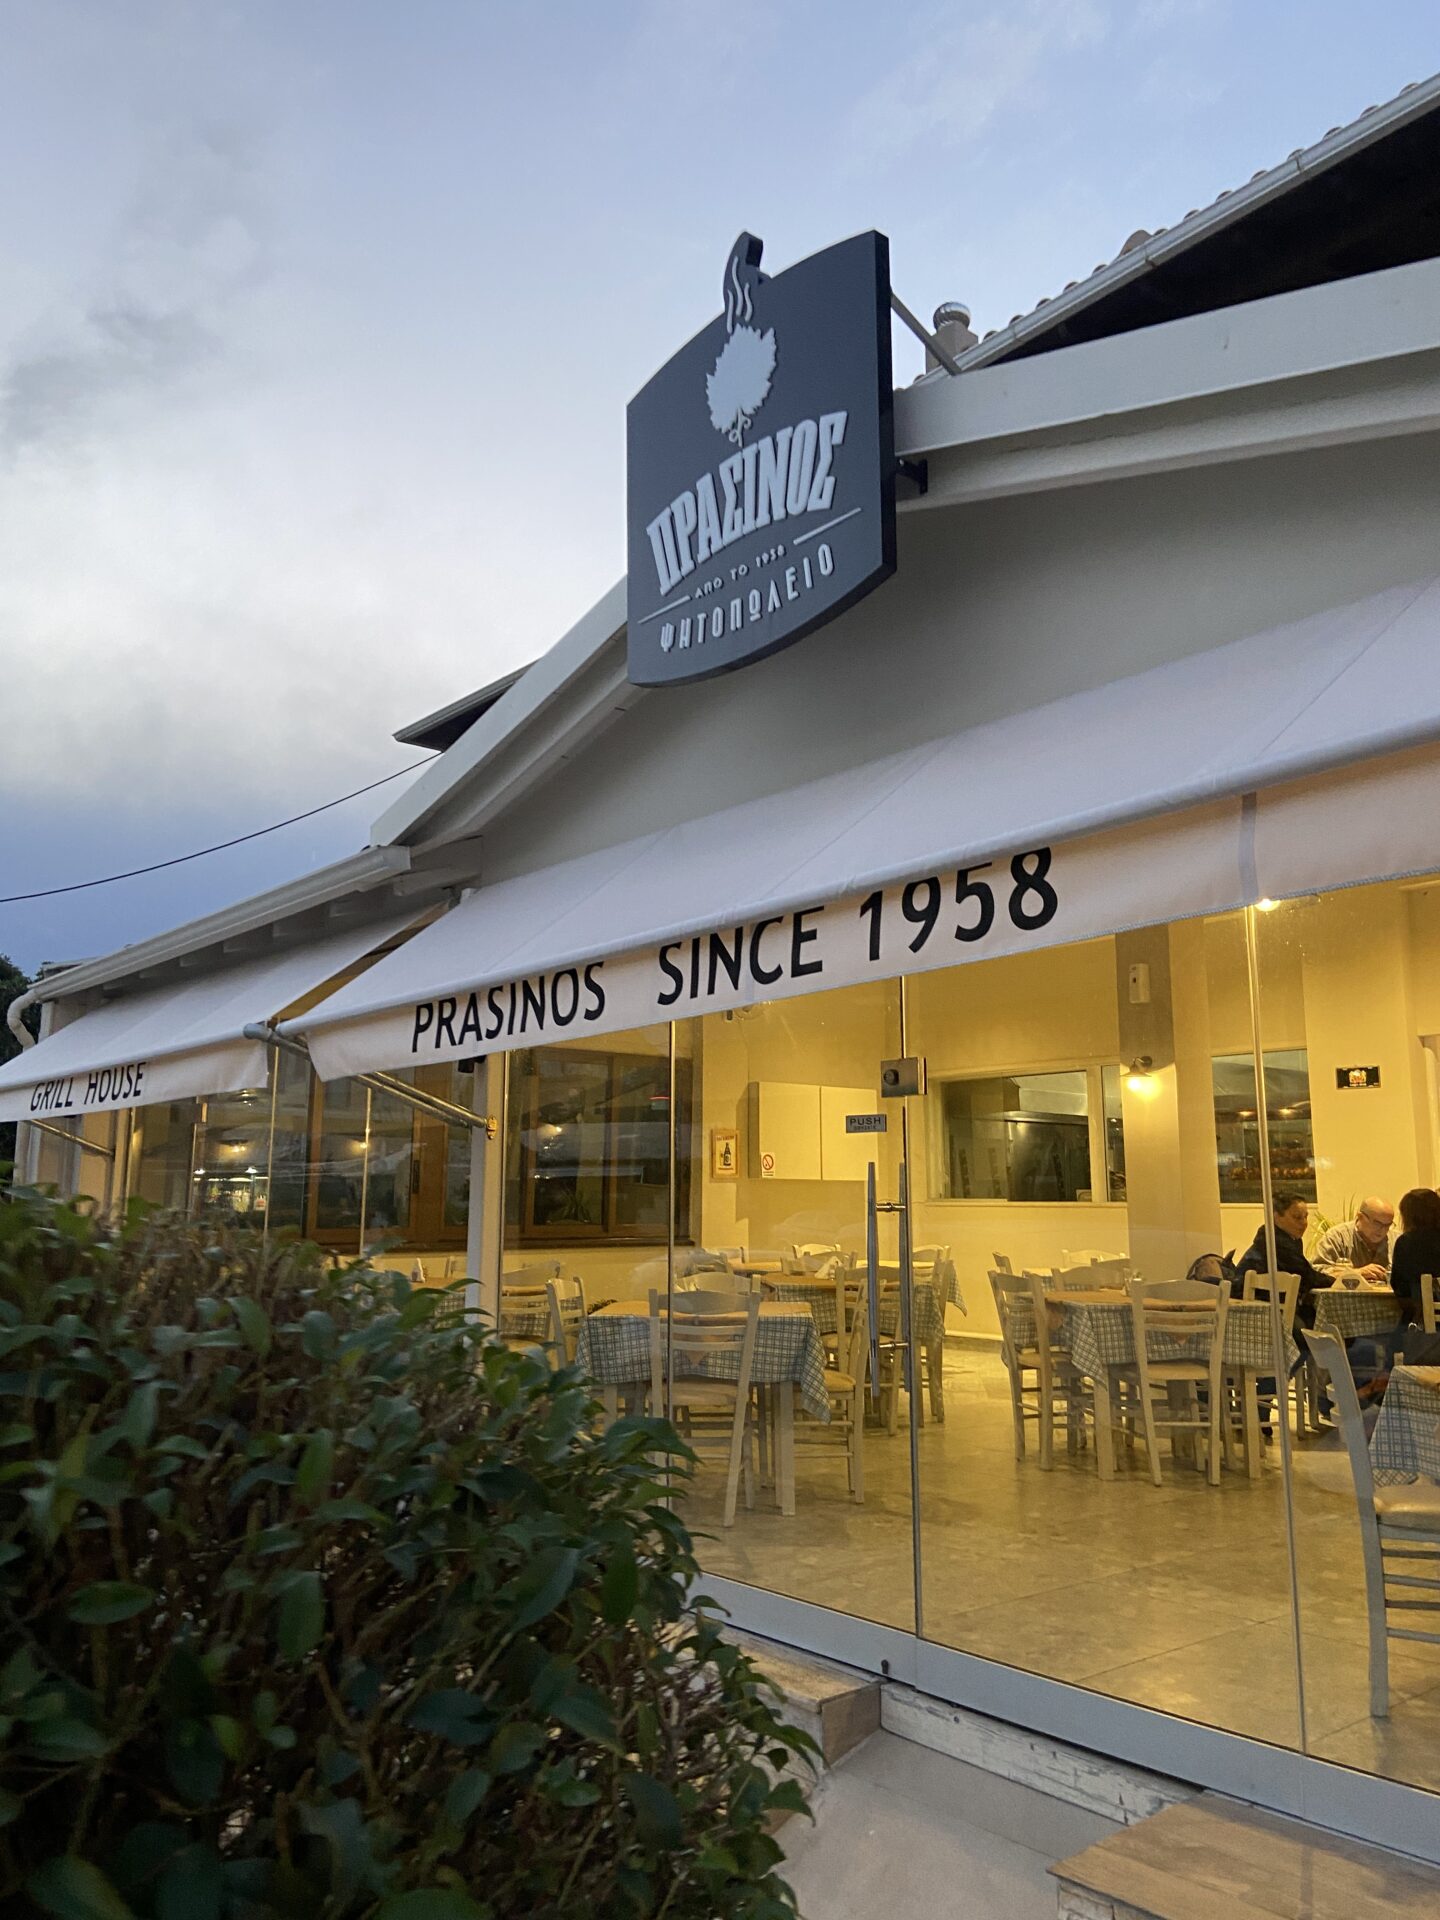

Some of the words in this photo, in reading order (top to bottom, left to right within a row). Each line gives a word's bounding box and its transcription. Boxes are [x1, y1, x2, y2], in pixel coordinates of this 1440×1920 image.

[646, 411, 848, 596] ΠΡΑΣΙΝΟΣ
[661, 543, 834, 653] ΨΗΤΟΠΩΛΕΙΟ
[695, 577, 723, 598] ΑΠΟ
[730, 564, 748, 580] ΤΟ
[756, 544, 785, 568] 1958
[411, 961, 605, 1053] PRASINOS
[657, 905, 825, 1006] SINCE
[860, 847, 1058, 961] 1958
[30, 1077, 74, 1111] GRILL
[84, 1061, 147, 1105] HOUSE
[849, 1116, 881, 1126] PUSH
